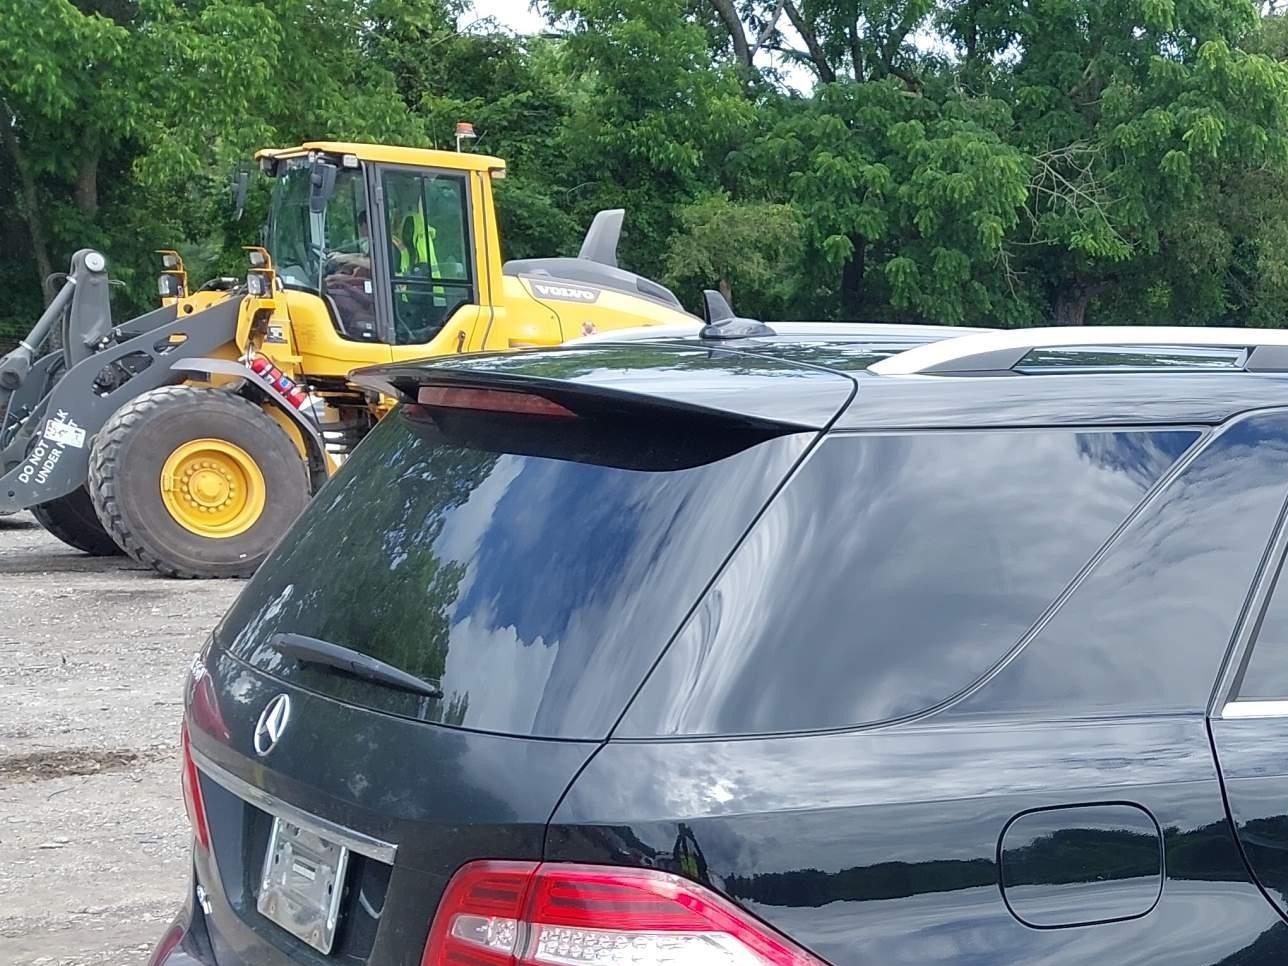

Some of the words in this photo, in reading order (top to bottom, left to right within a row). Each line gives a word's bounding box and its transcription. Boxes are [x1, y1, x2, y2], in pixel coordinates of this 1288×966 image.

[534, 284, 595, 300] VOLVO
[18, 465, 34, 484] DO
[29, 439, 49, 466] NOT
[34, 448, 63, 484] UNDER
